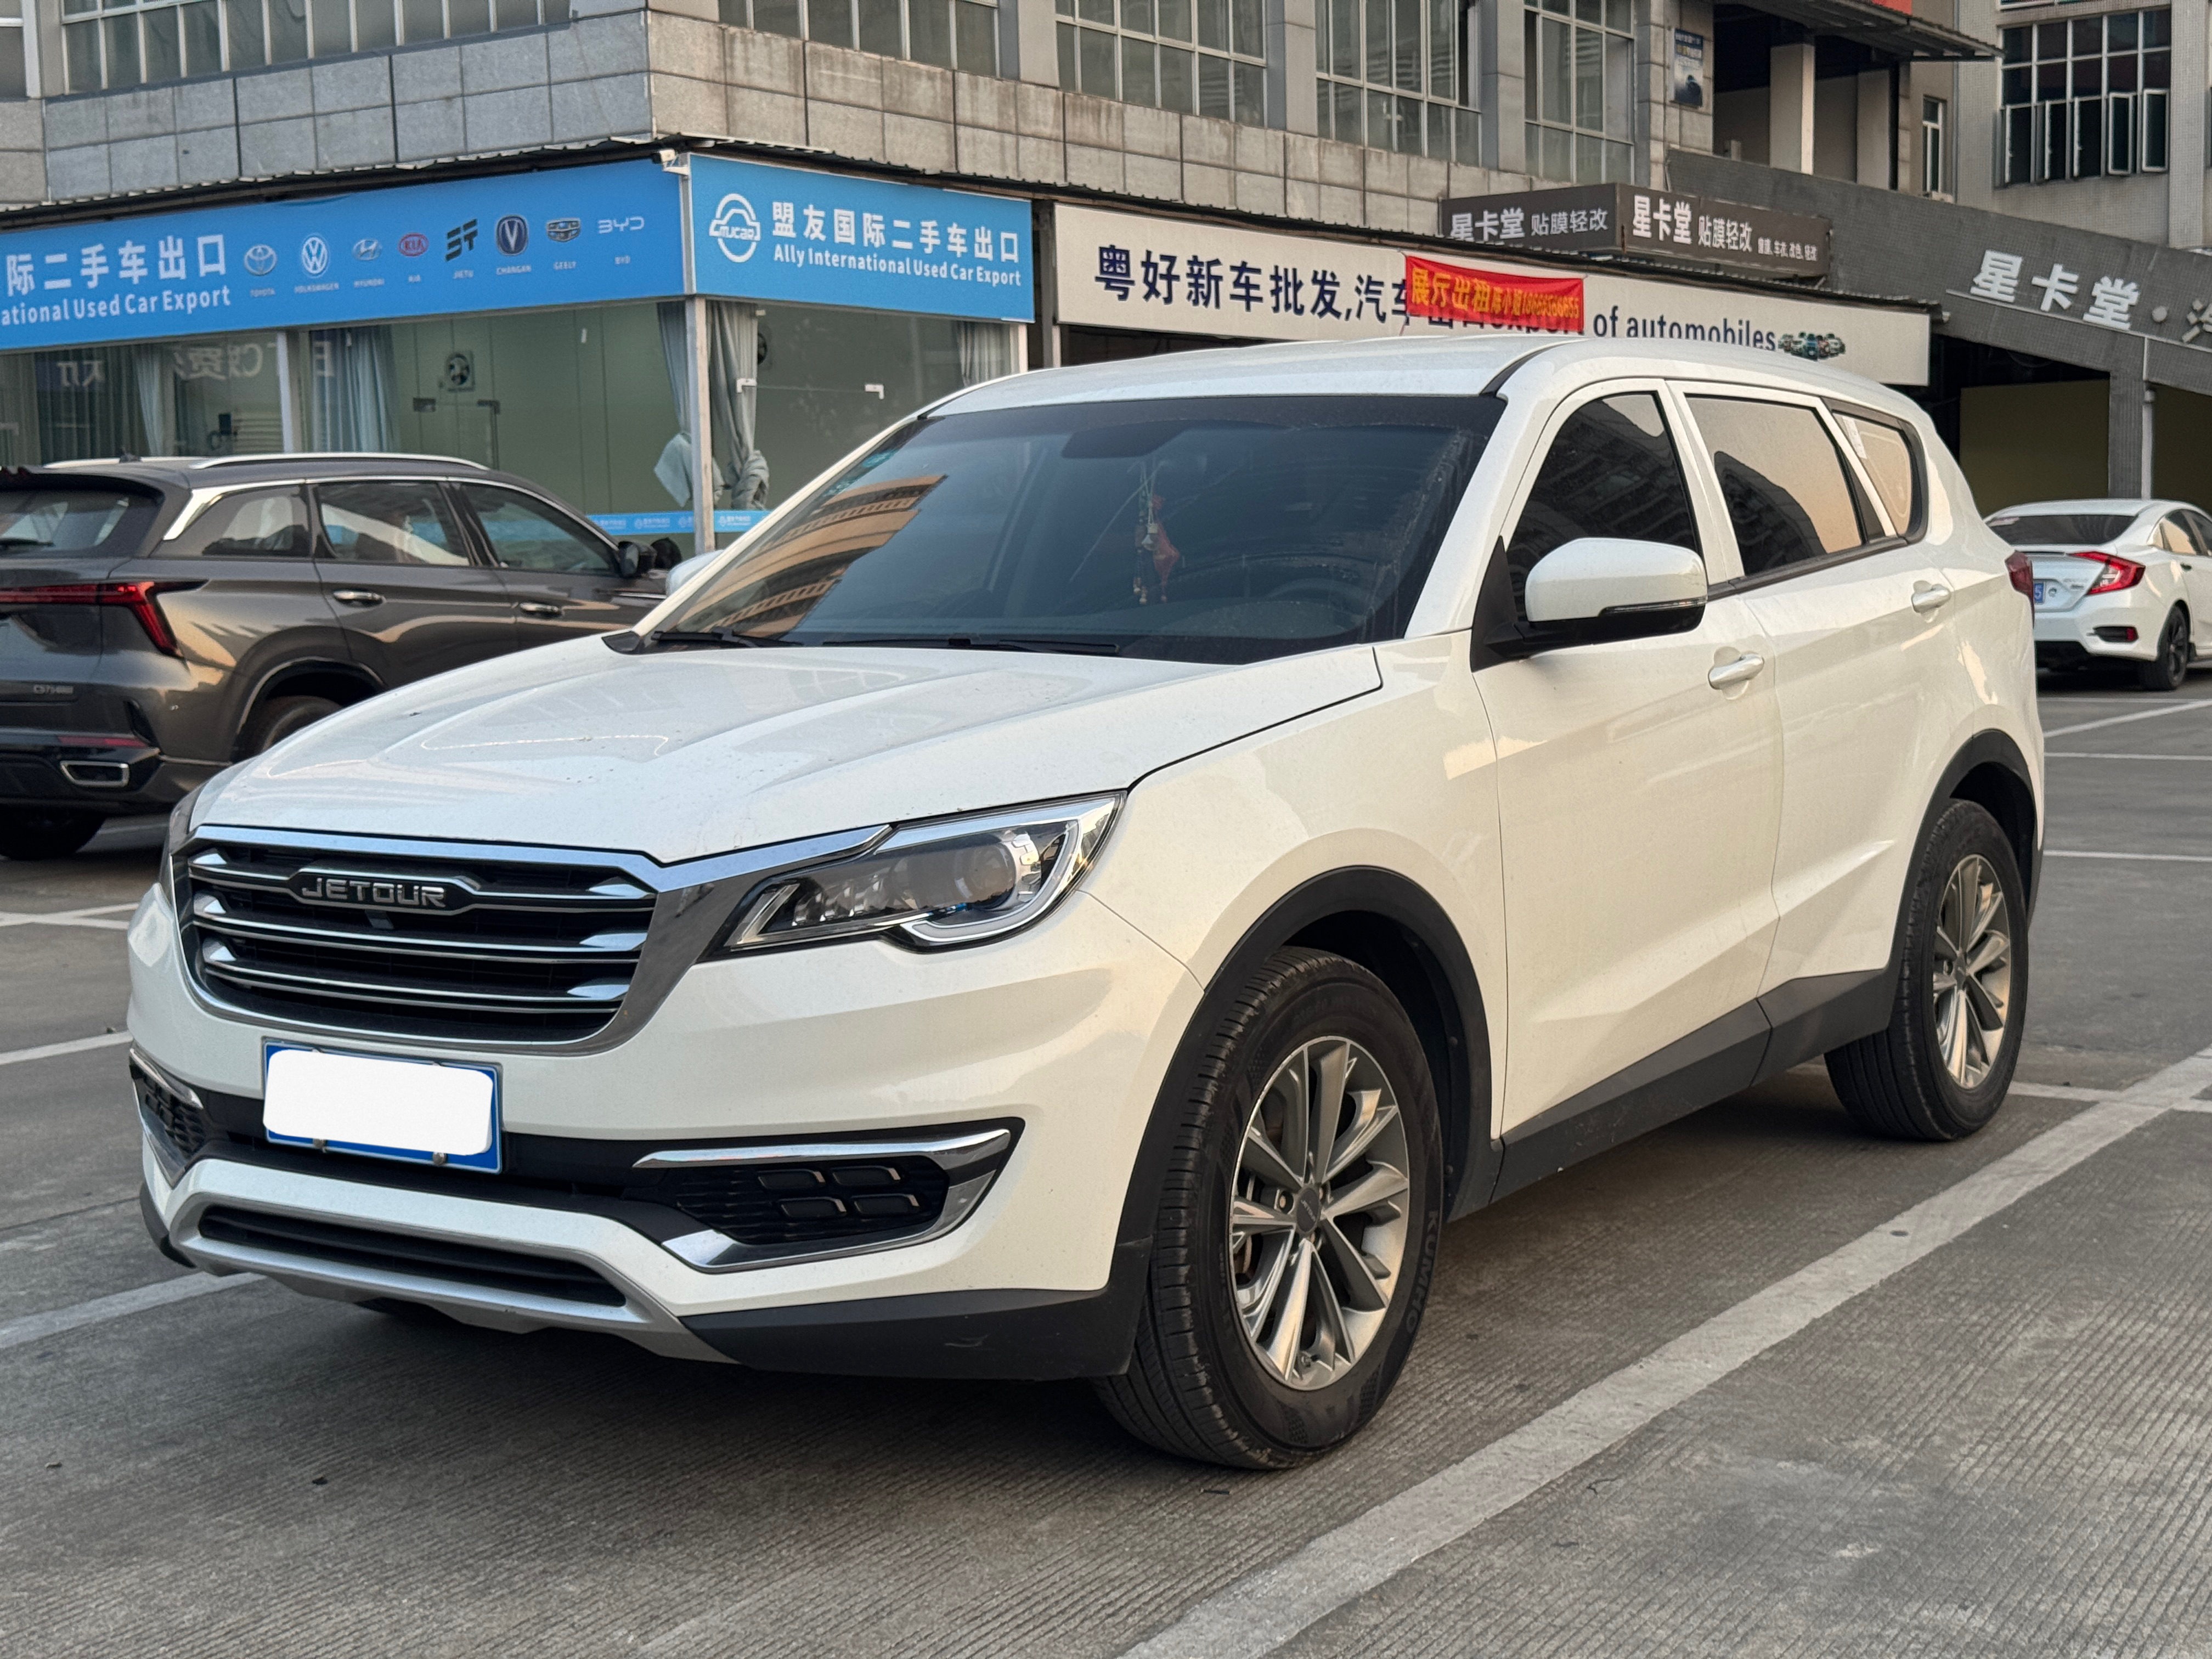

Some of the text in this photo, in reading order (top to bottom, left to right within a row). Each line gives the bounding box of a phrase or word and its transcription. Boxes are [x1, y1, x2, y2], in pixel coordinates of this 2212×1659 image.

[772, 201, 1019, 263] 盟友国际二手车出口
[1451, 207, 1609, 241] 星卡堂 贴膜轻改
[1633, 195, 1691, 244] 星卡堂
[1698, 215, 1753, 252] 贴膜轻改
[774, 244, 1022, 288] Ally International Used Car Export
[74, 292, 120, 319] Used
[125, 294, 157, 314] Car
[164, 285, 231, 315] Export
[1593, 305, 1618, 338] of
[302, 878, 446, 908] JETOUR
[1406, 1210, 1438, 1334] KUMHO
